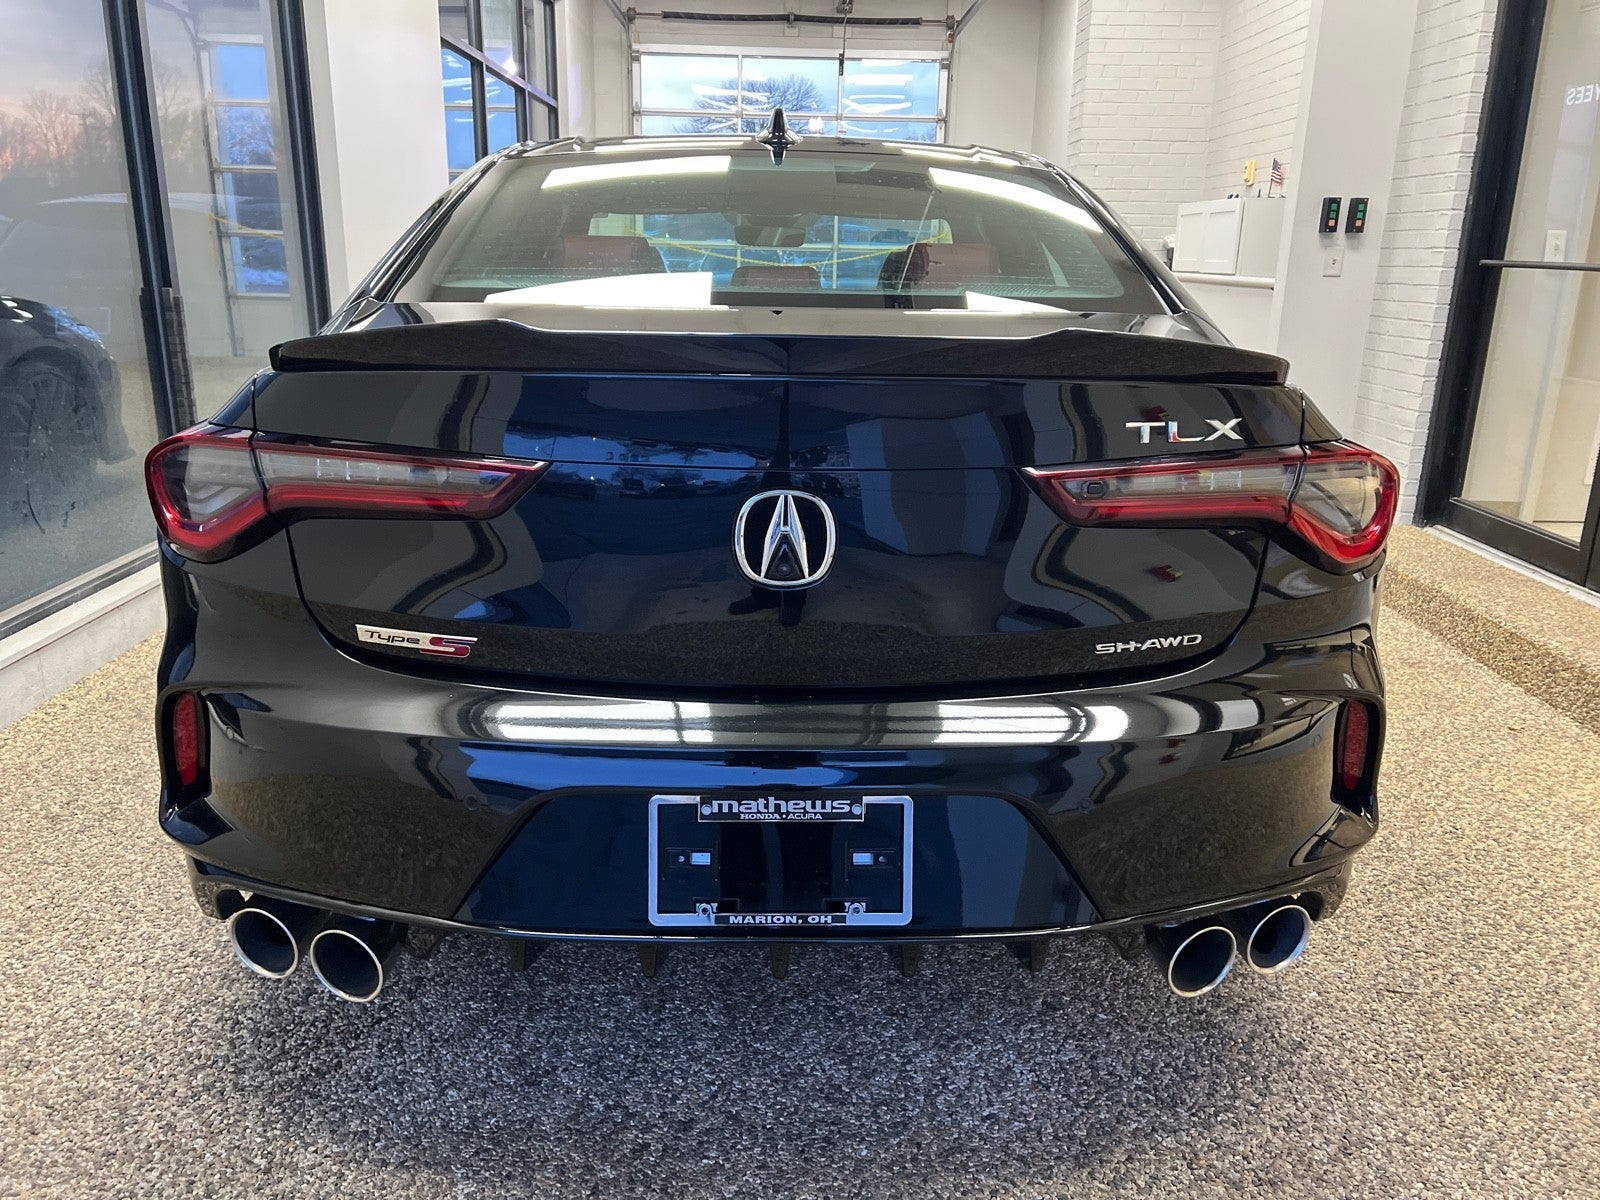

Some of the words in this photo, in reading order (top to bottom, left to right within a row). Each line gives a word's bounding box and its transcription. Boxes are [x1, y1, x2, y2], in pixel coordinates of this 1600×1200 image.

[1125, 417, 1244, 444] TLX
[364, 629, 421, 645] Type
[420, 635, 477, 658] S
[1094, 633, 1203, 655] SH-AWD
[711, 796, 850, 814] mathews
[729, 915, 803, 925] MARION,
[808, 915, 832, 925] OH
